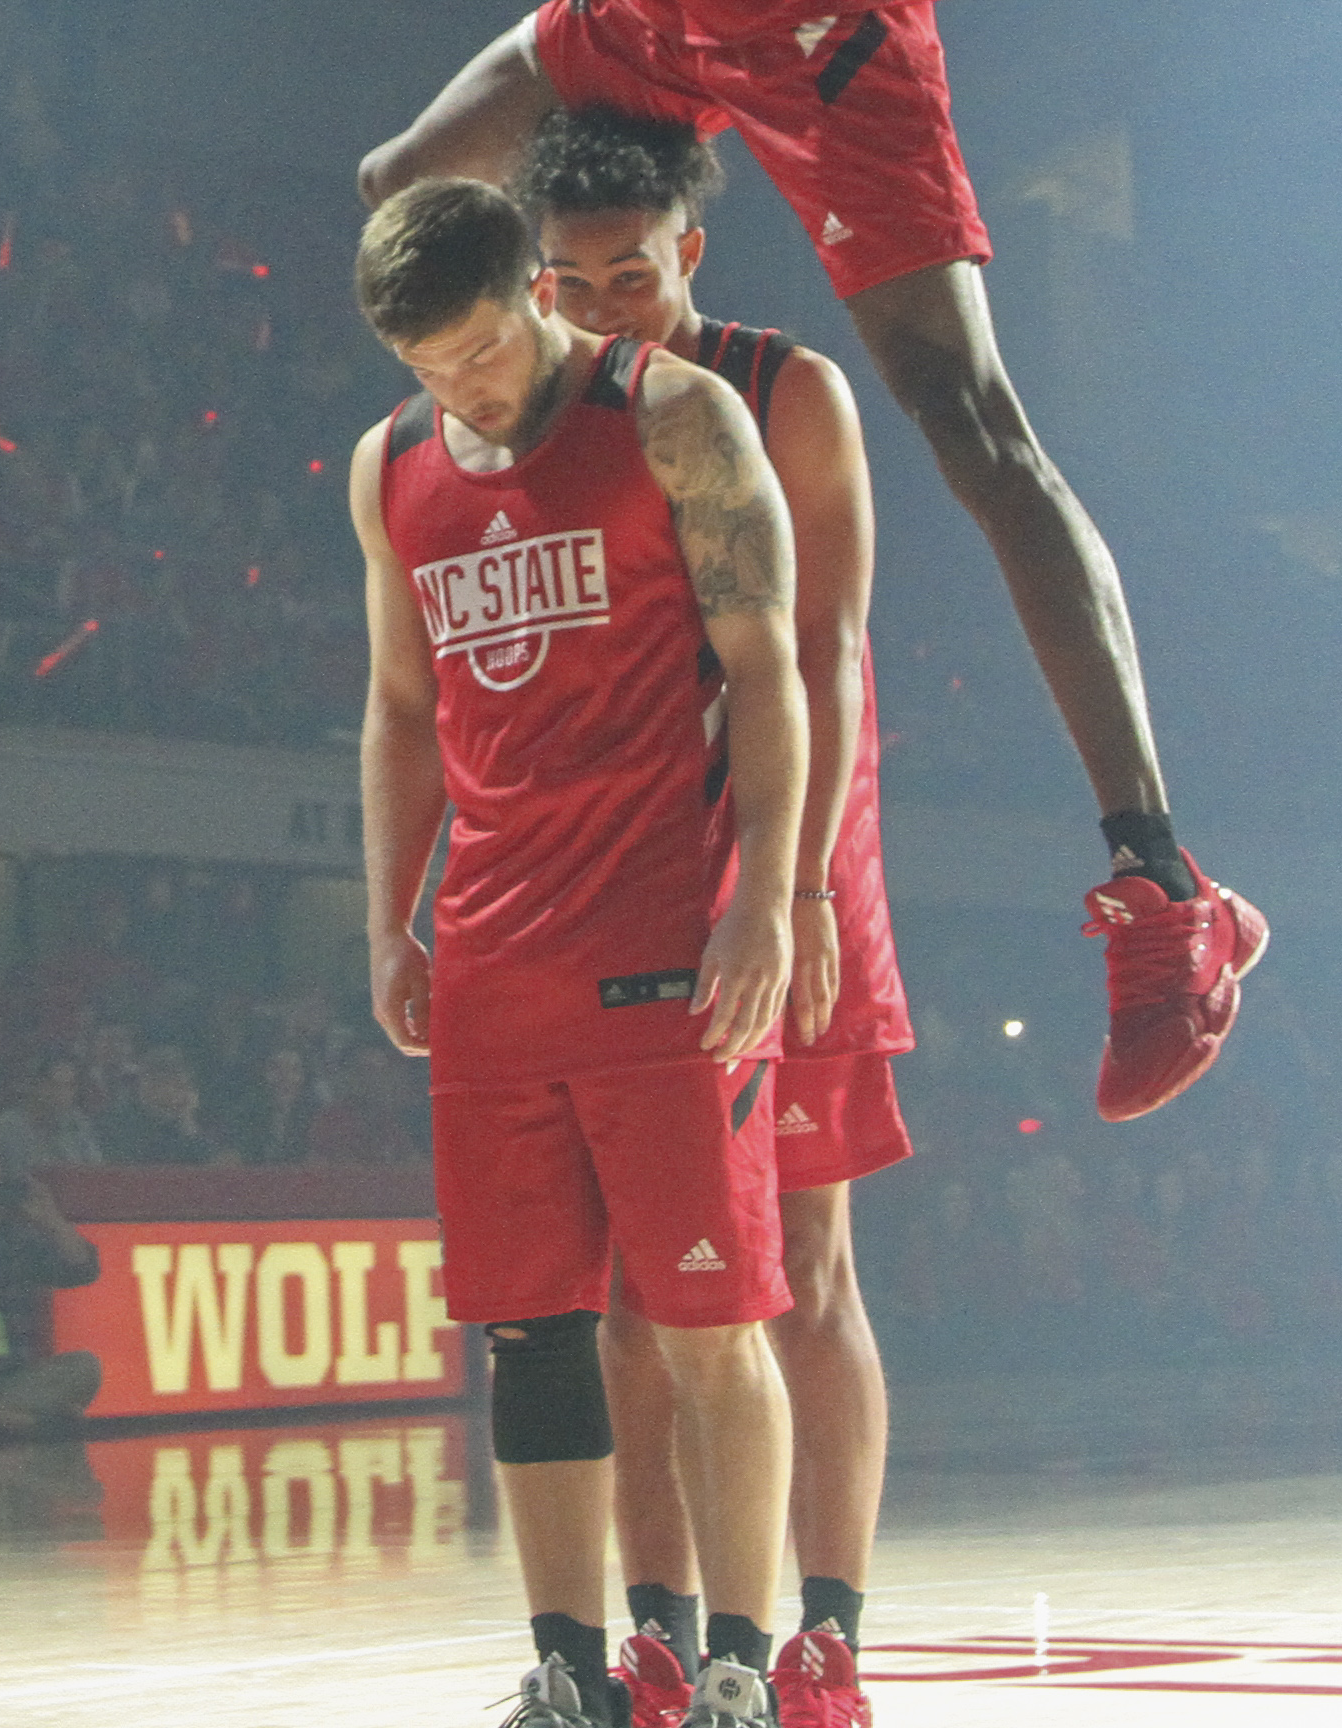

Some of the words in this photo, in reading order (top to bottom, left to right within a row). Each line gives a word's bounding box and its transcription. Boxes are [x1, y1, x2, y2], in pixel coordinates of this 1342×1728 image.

[419, 563, 470, 638] NC
[478, 536, 602, 621] STATE
[677, 1259, 727, 1272] adidas
